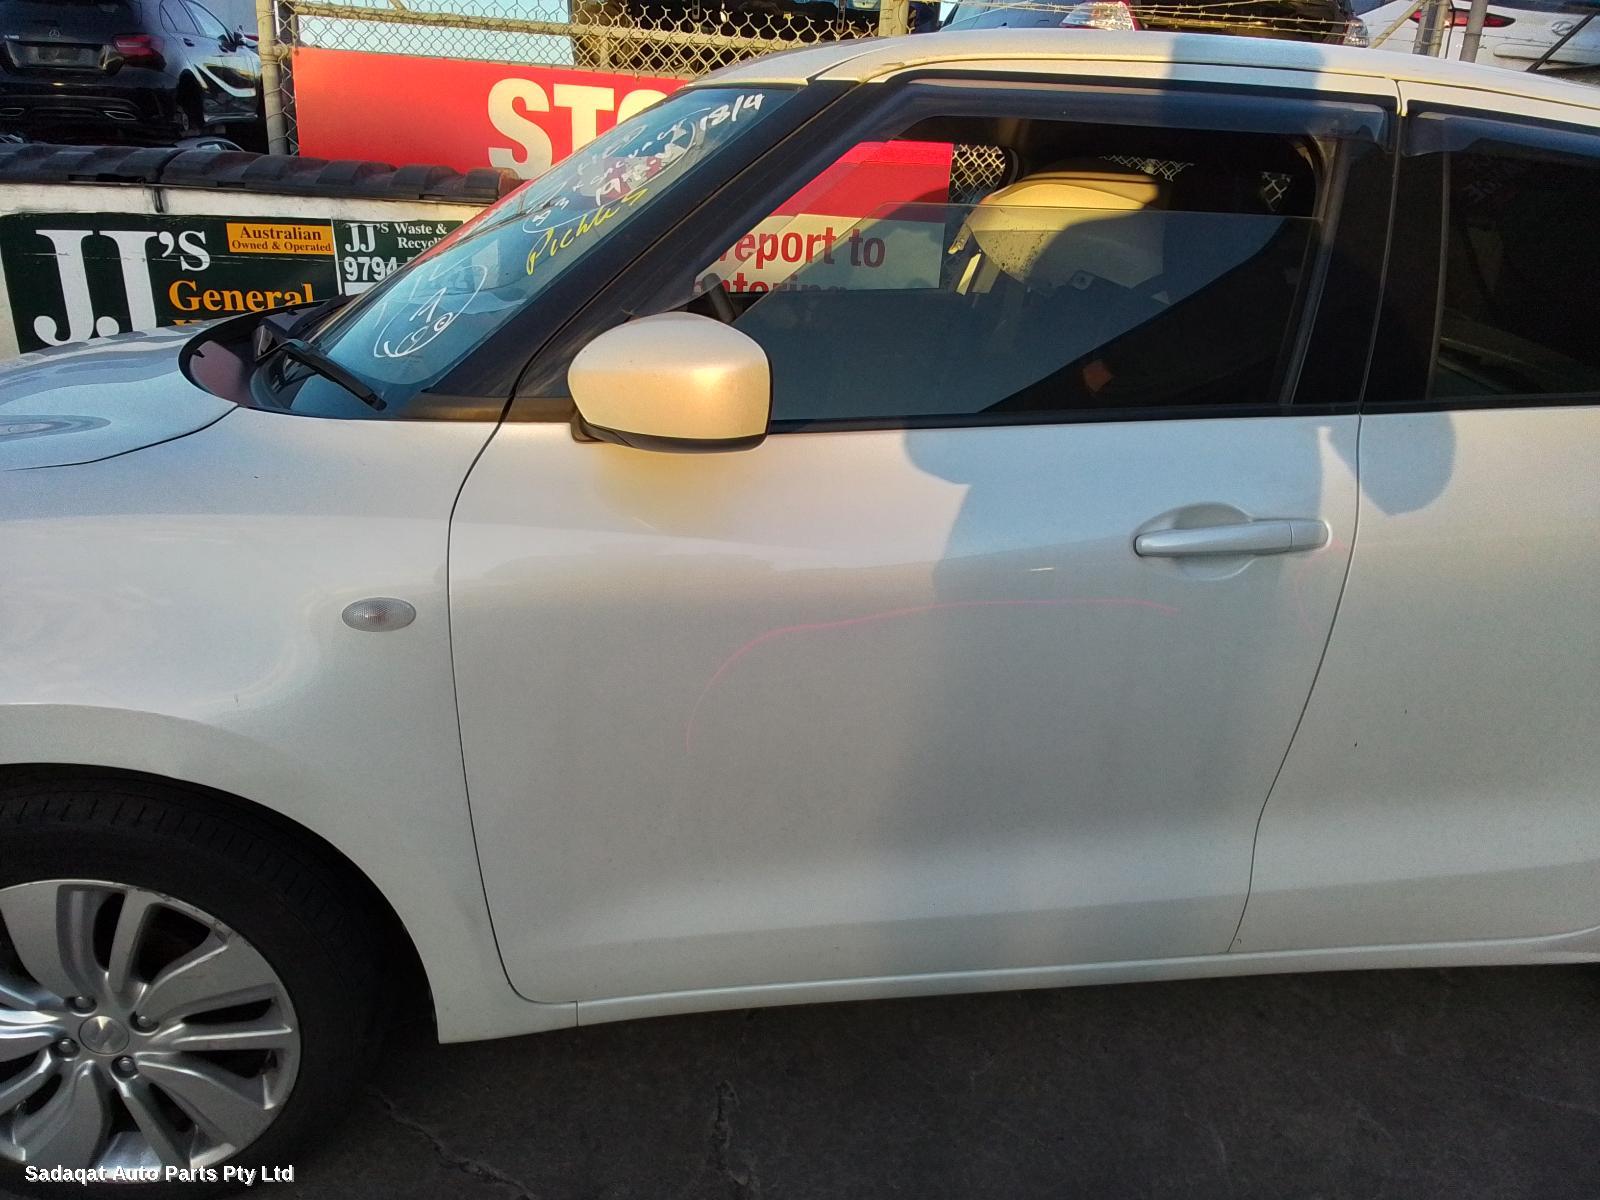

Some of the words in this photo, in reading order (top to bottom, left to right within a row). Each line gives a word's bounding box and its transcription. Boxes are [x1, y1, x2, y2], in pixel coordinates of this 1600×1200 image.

[487, 78, 668, 180] ST
[231, 240, 269, 250] Owned
[271, 241, 281, 251] &
[283, 241, 332, 253] Operated
[240, 225, 322, 241] Australian
[345, 222, 389, 253] JJ'S
[394, 223, 433, 235] Waste
[435, 223, 448, 235] &
[719, 227, 837, 270] eport
[848, 228, 886, 268] to
[168, 280, 314, 313] General
